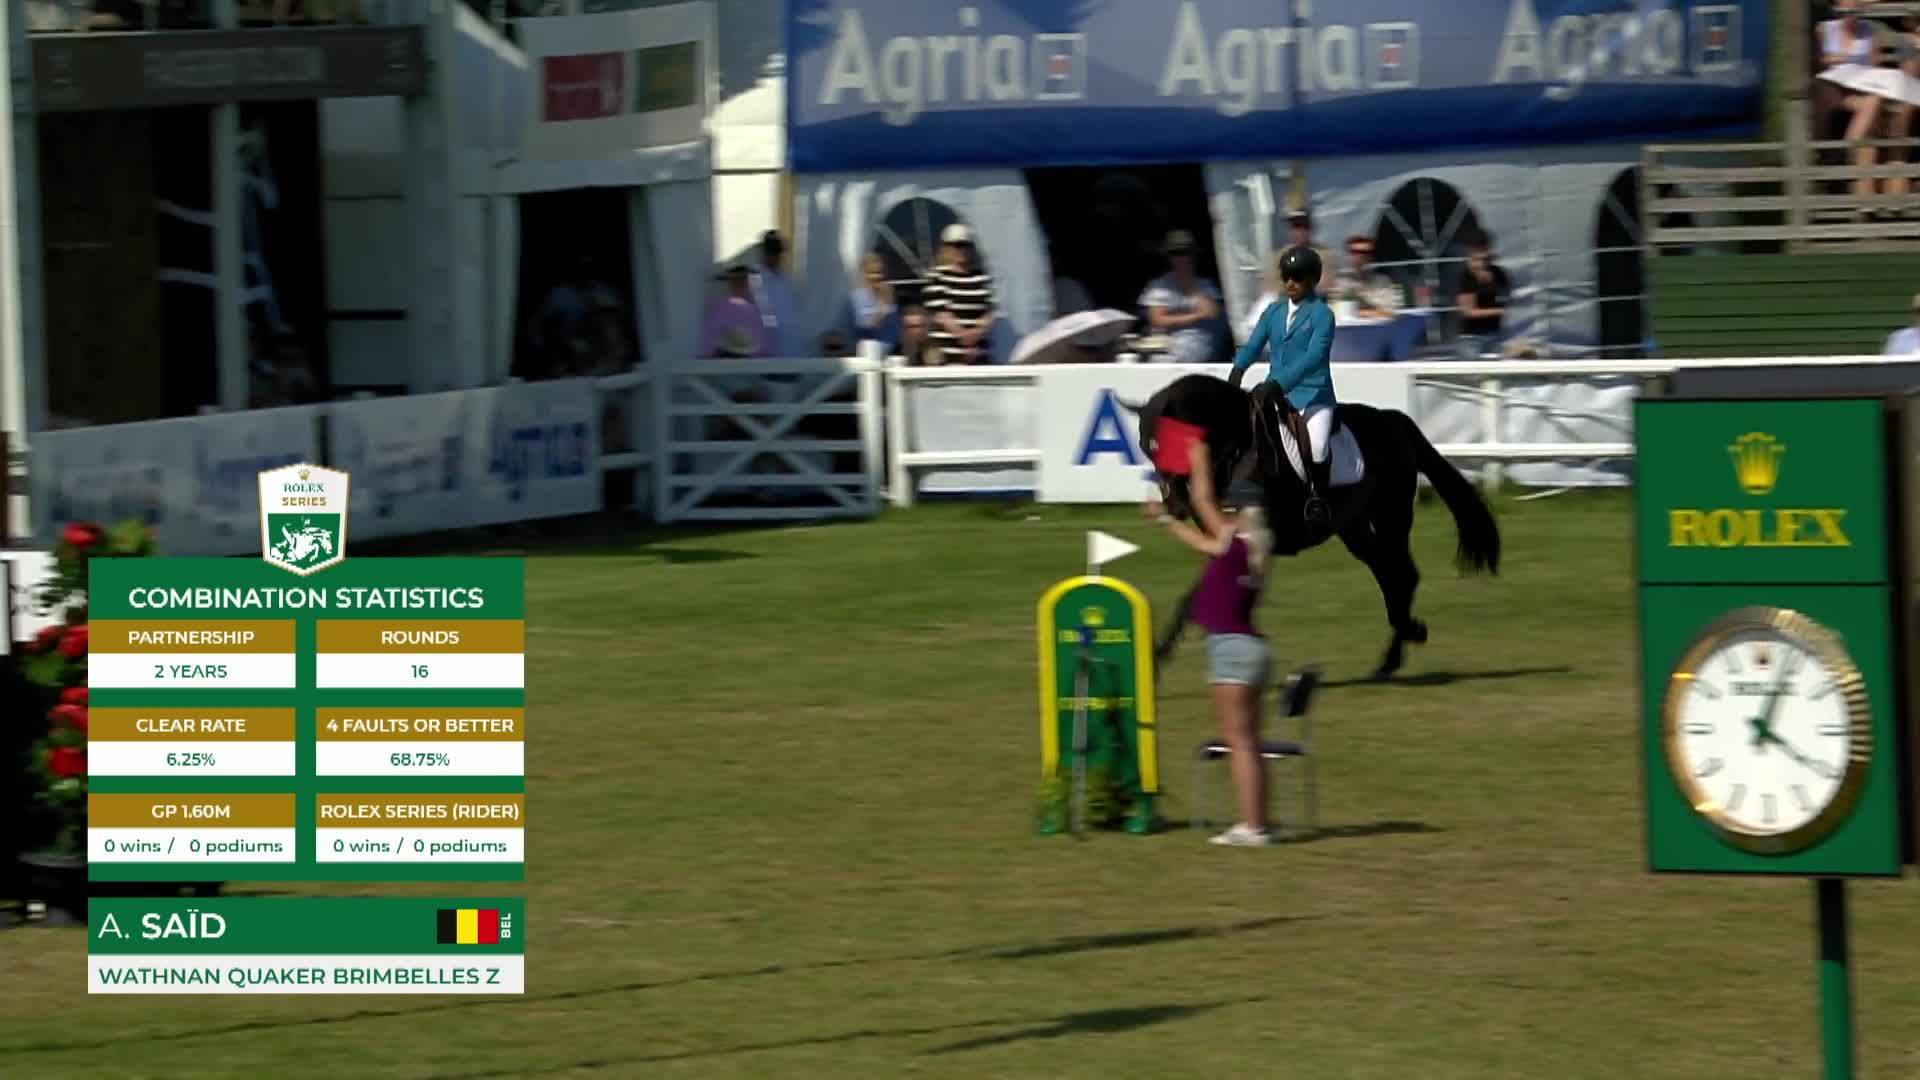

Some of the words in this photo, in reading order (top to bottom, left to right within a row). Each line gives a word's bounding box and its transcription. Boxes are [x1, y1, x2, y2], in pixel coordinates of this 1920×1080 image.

[816, 7, 1027, 126] Agria
[1156, 0, 1362, 117] Agria
[1667, 508, 1851, 547] ROLEX
